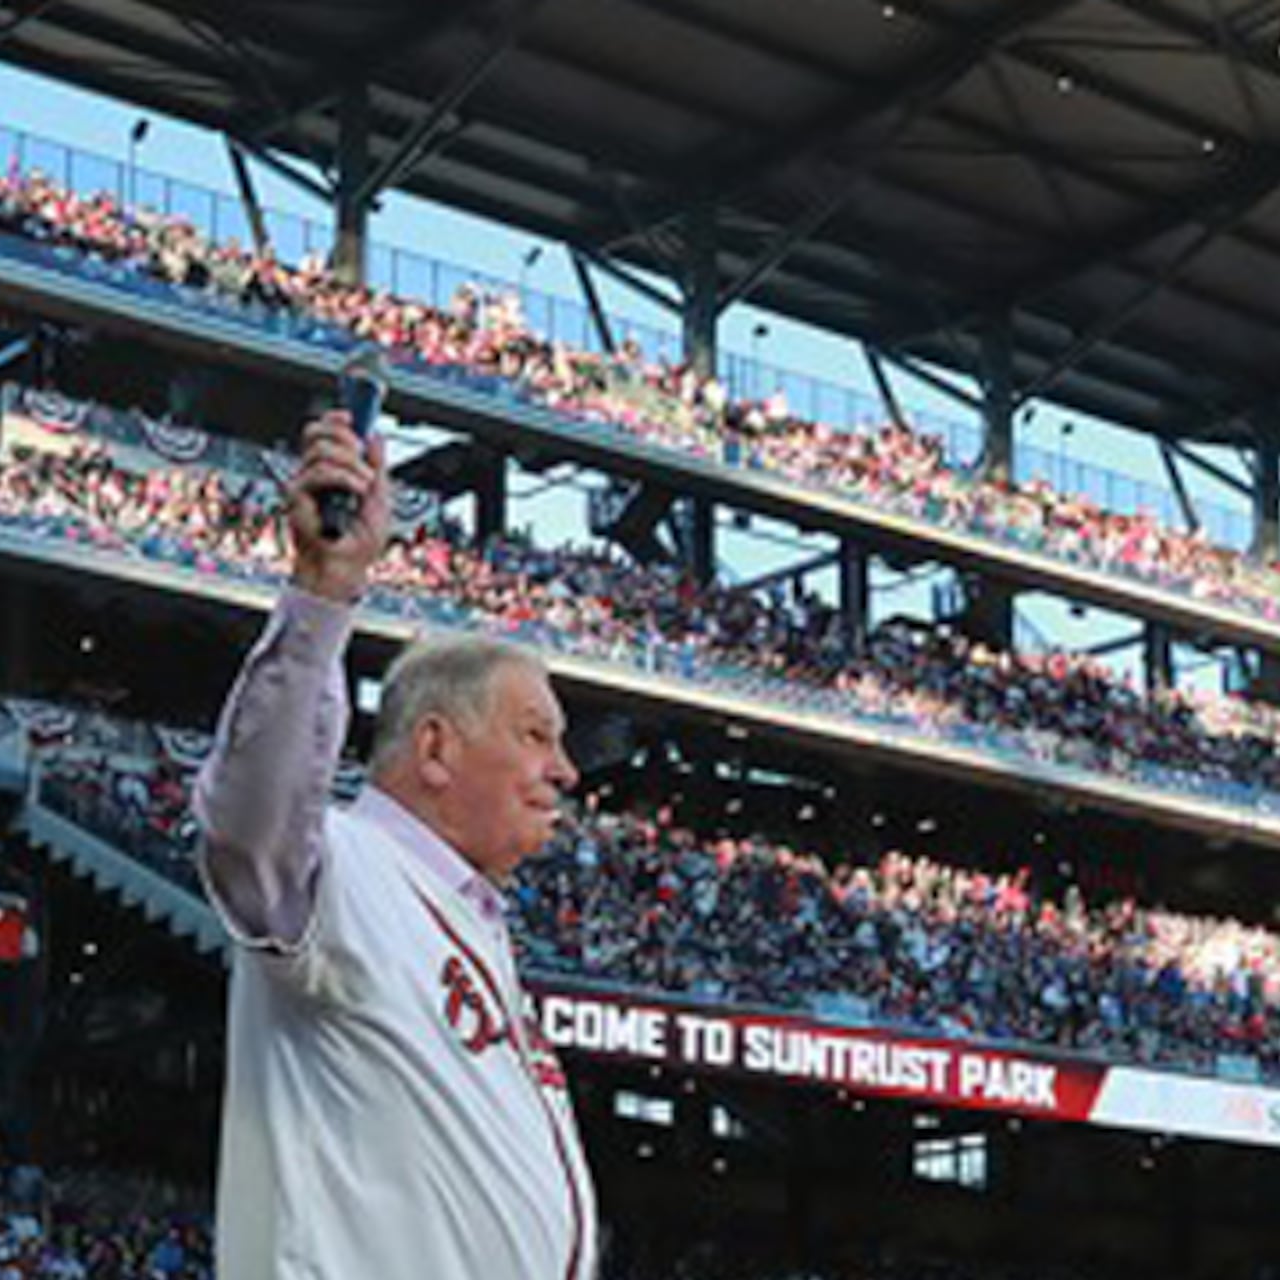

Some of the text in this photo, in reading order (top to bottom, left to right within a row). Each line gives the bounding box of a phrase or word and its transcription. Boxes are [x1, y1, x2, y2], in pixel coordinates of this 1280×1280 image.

[677, 1013, 733, 1064] TO
[744, 1025, 950, 1093] SUNTRUST
[958, 1053, 1058, 1107] PARK
